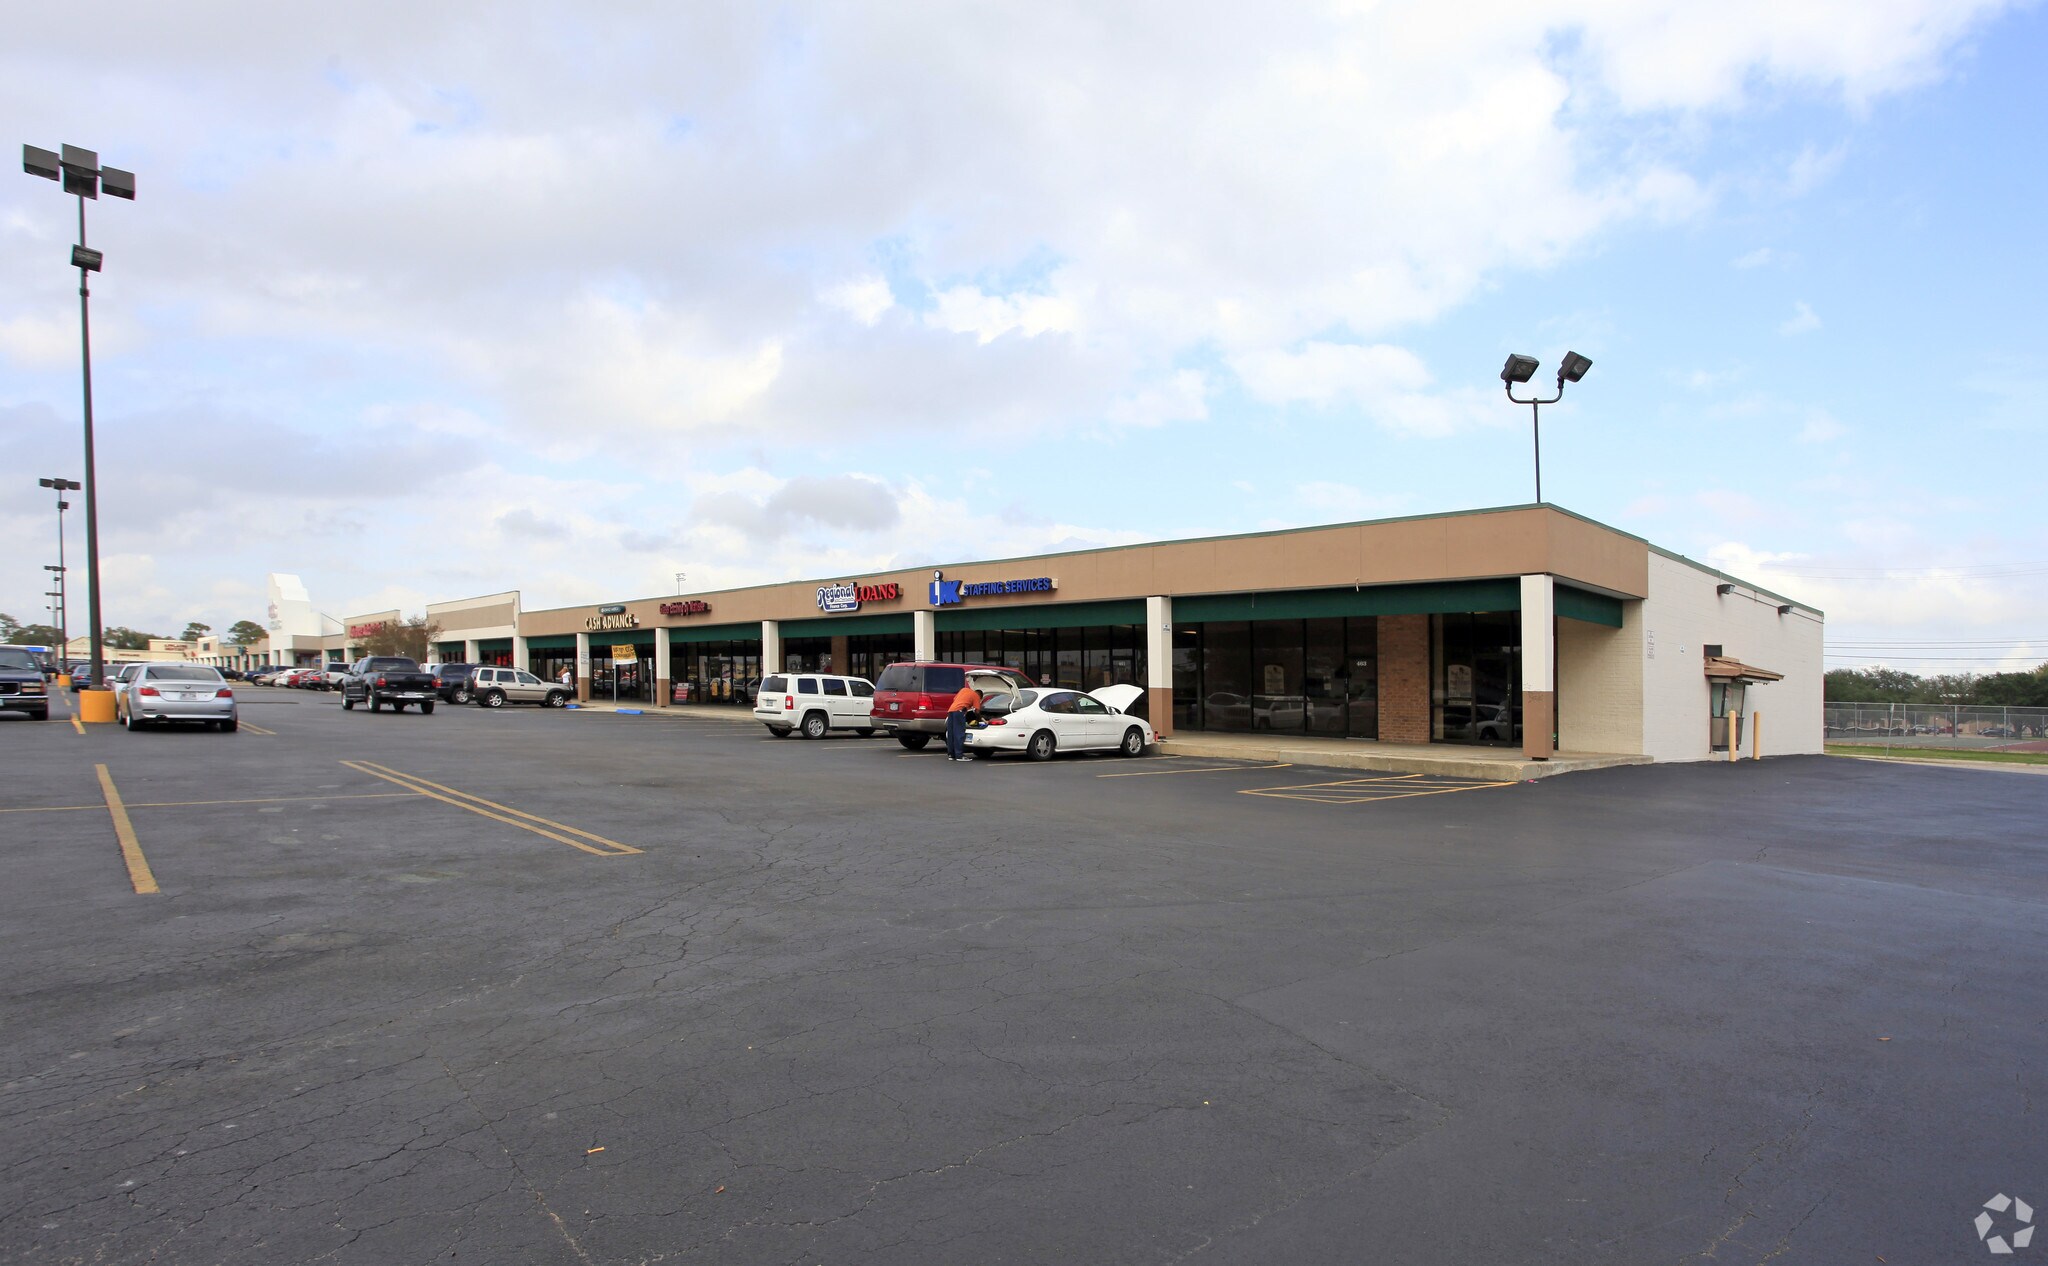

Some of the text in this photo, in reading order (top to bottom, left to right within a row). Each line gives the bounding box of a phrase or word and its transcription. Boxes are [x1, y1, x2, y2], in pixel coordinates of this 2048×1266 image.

[817, 582, 897, 605] Regional LOANS
[963, 581, 1003, 596] STAFFING
[1005, 577, 1051, 593] SERVICES
[585, 613, 633, 630] CASH ADVANCE
